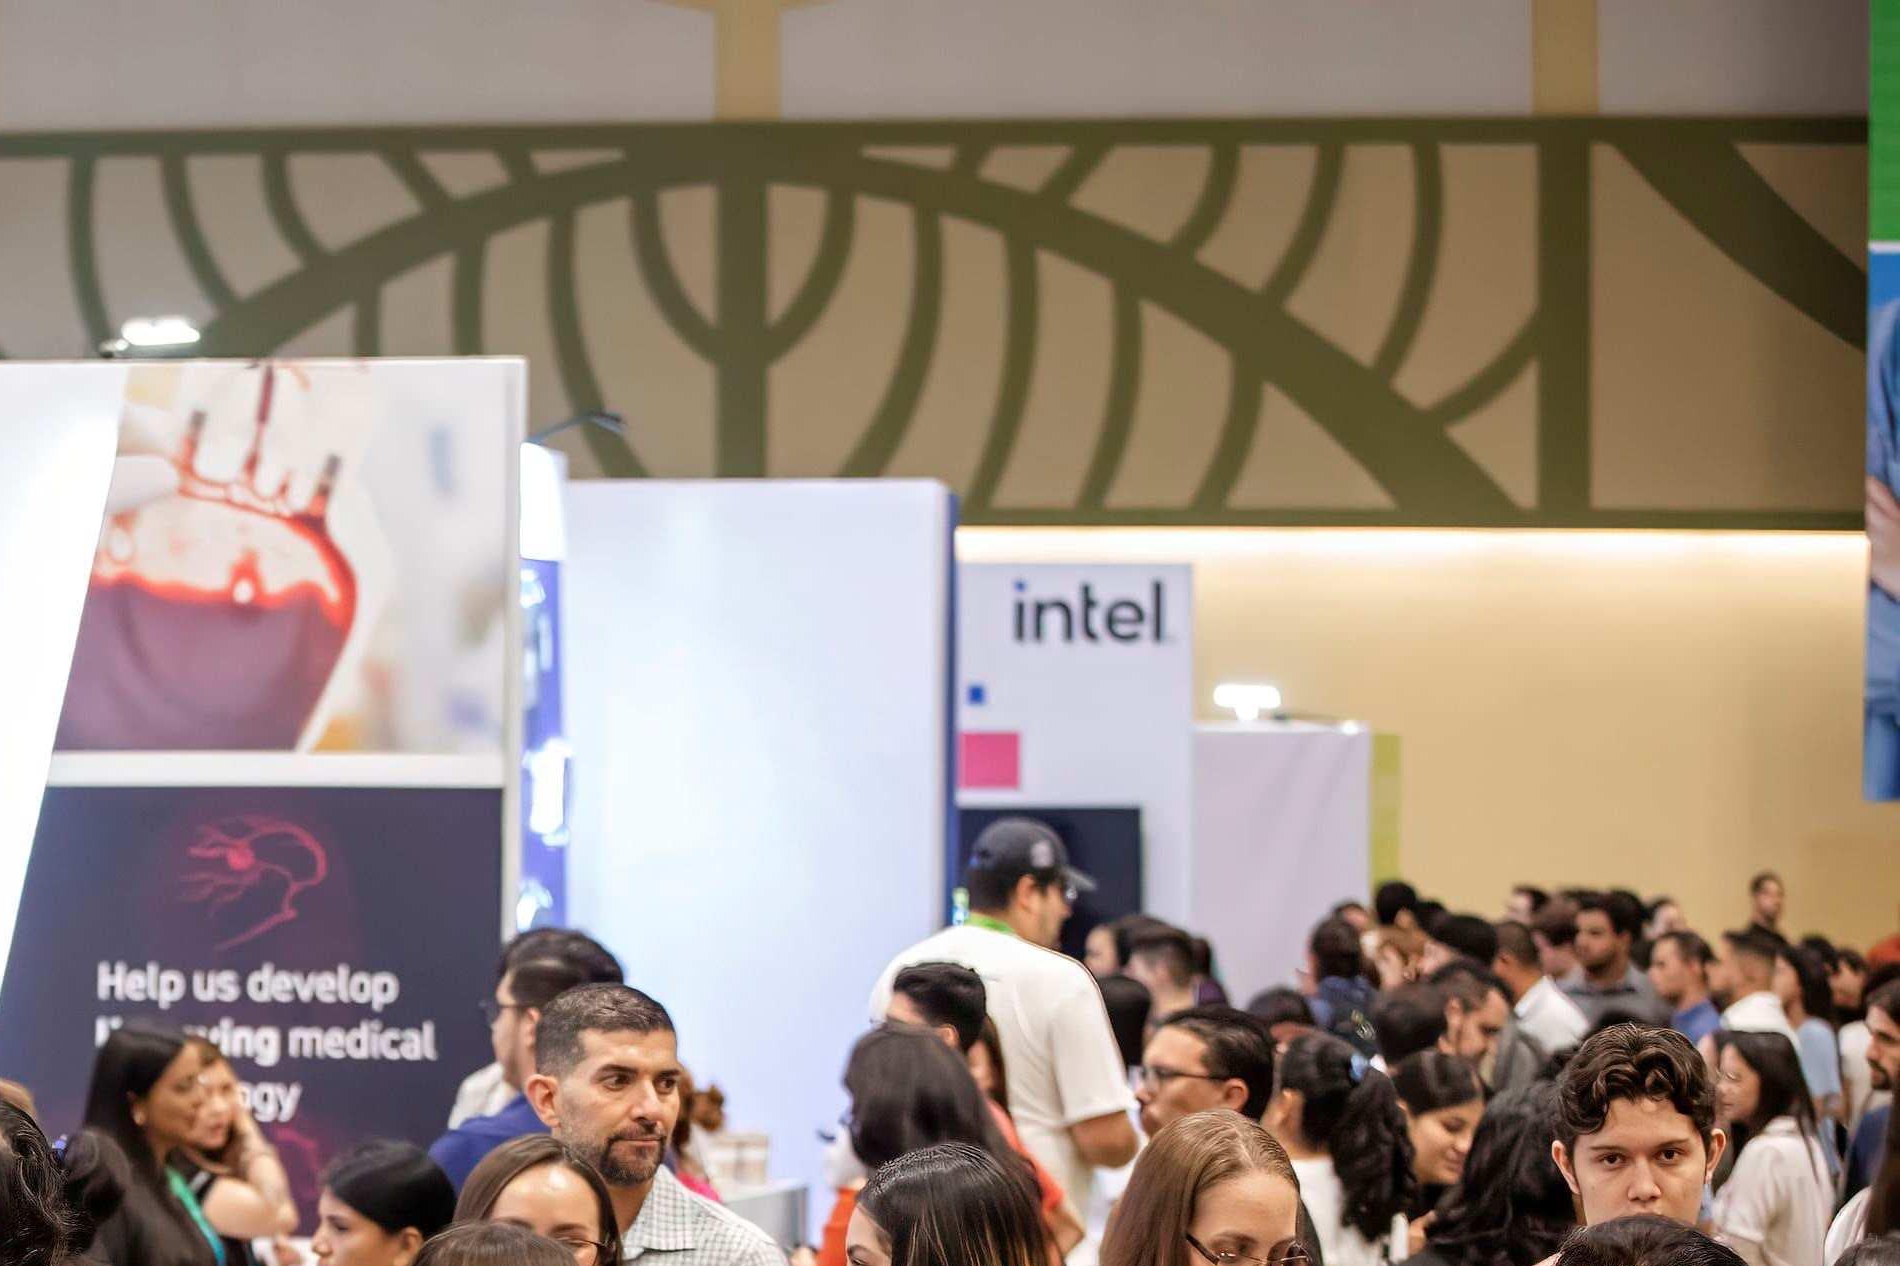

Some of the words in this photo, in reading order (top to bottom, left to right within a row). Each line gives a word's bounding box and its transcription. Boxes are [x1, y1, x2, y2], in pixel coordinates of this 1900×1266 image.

[1014, 578, 1165, 643] intel
[96, 961, 187, 1010] Help
[192, 968, 241, 1002] us
[247, 962, 400, 1012] develop
[288, 1020, 439, 1061] medical
